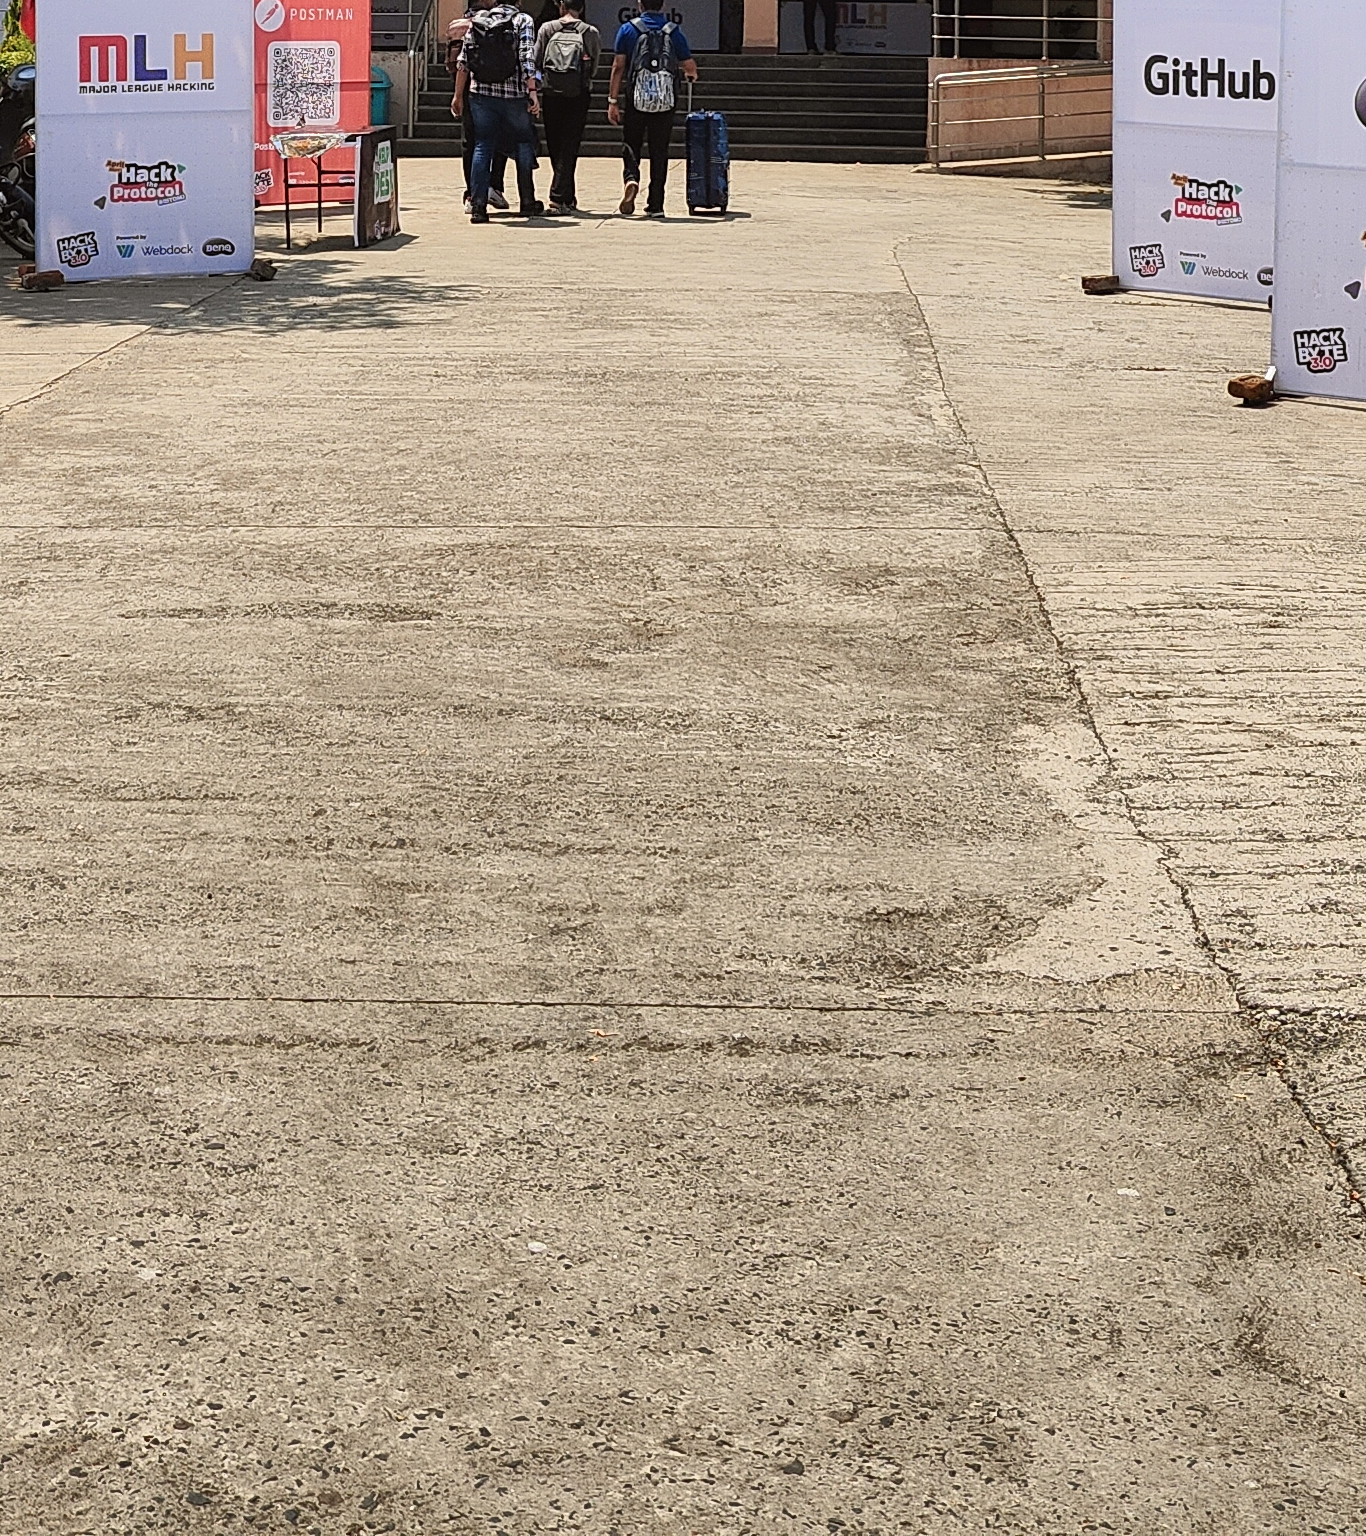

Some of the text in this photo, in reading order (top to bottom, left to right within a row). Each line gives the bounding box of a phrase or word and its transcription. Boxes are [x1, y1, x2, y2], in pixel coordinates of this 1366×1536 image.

[290, 8, 353, 21] POSTMAN
[79, 33, 215, 83] MLH
[1144, 54, 1276, 101] GitHub
[79, 82, 215, 94] MAJOR LEAGUE HACKING
[121, 164, 173, 183] Hack
[113, 184, 181, 199] Protocol
[1184, 182, 1232, 201] Hack
[1177, 202, 1237, 218] Protocol
[59, 233, 95, 250] HACK
[206, 243, 233, 252] BenQ
[61, 246, 97, 263] BYTE
[141, 244, 194, 257] Webdock
[1131, 246, 1161, 259] HACK
[71, 253, 89, 264] 3.0
[1133, 257, 1164, 271] BYTE
[1141, 265, 1156, 274] 3.0
[1201, 265, 1249, 280] Webdock
[1296, 331, 1343, 349] HACK
[1298, 346, 1345, 364] BYTE
[1310, 356, 1334, 369] 3.0
